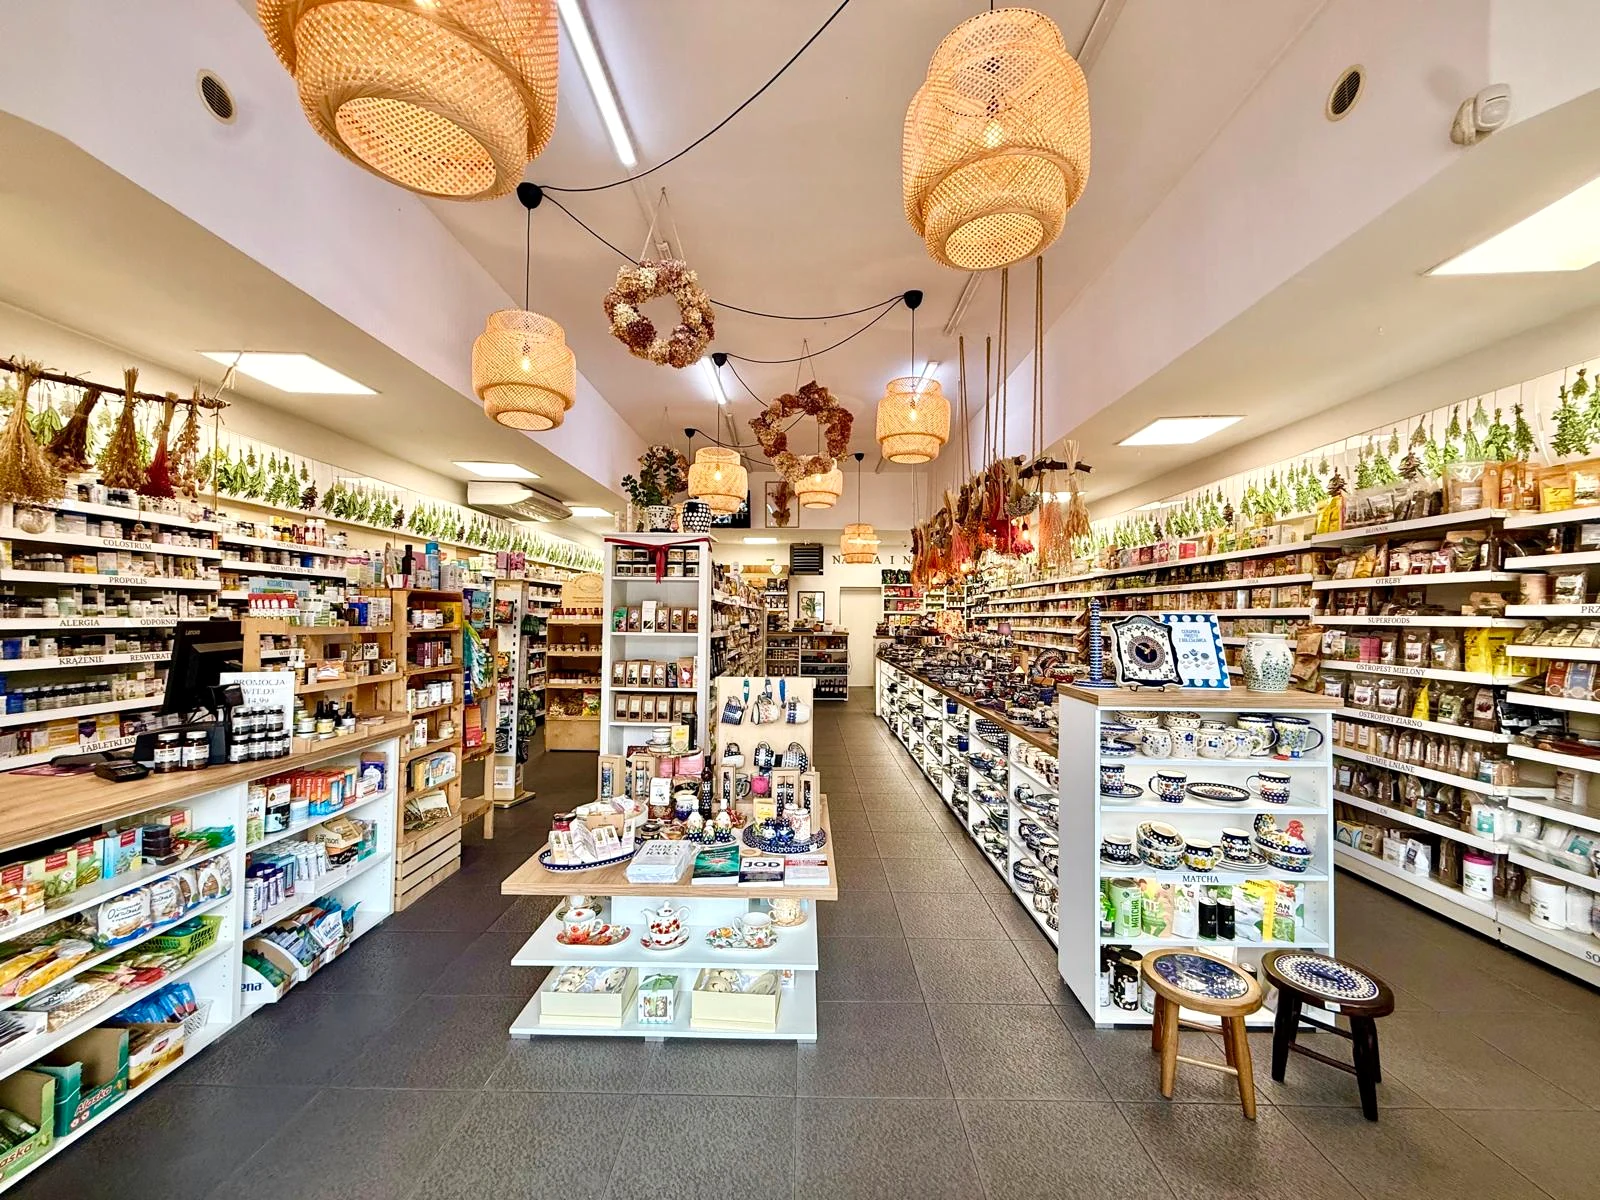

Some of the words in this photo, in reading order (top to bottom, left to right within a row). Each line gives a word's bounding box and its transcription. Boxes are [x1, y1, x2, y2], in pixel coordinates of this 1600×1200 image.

[102, 539, 152, 551] COLOSTRUM
[270, 565, 296, 573] WITAMINA
[109, 575, 147, 585] PROPOLIS
[1581, 605, 1600, 614] PRZ
[60, 619, 100, 628] ALERGIA
[1368, 616, 1410, 625] SUPERFOODS
[59, 656, 104, 666] KRĄŻENIE
[1357, 663, 1391, 674] OSTROPEST
[1393, 666, 1425, 676] MIELONY
[1359, 711, 1393, 723] OSTROPEST
[1395, 716, 1422, 726] ZIARNO
[80, 740, 122, 753] TABLETKI
[124, 737, 136, 746] DO
[1182, 875, 1219, 883] MATCHA
[1131, 900, 1139, 928] MATCHA
[75, 1086, 113, 1113] Alaska
